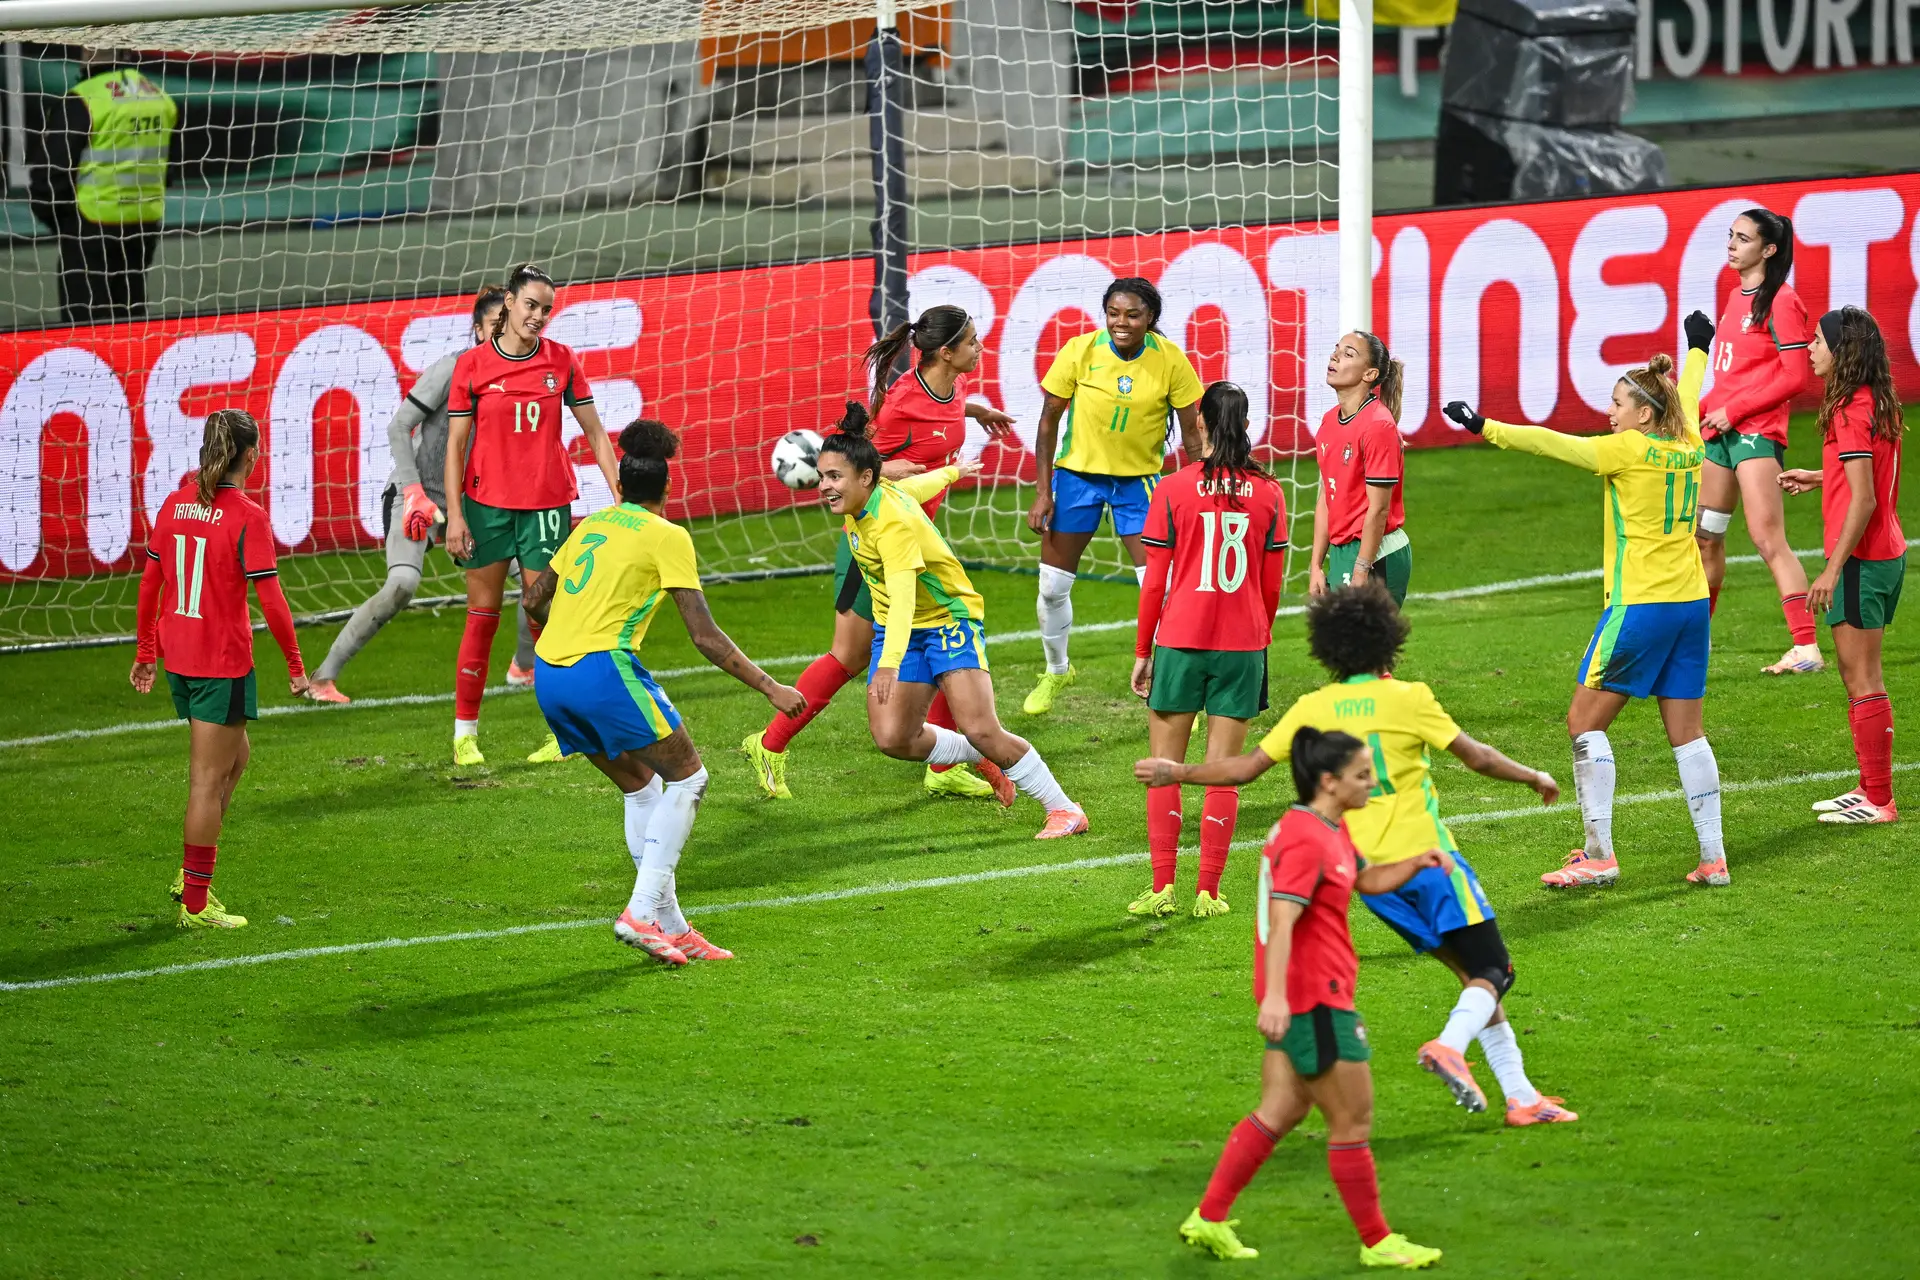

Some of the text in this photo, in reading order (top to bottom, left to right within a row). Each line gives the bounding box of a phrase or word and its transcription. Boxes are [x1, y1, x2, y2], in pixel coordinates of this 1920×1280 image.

[1715, 341, 1733, 372] 13
[514, 401, 541, 433] 19
[1110, 405, 1130, 433] 11
[1328, 477, 1337, 501] 3
[1664, 471, 1698, 535] 14
[173, 503, 224, 526] TATIANA P.
[538, 509, 561, 542] 19
[564, 533, 608, 595] 3
[1194, 511, 1250, 594] 18
[172, 533, 207, 619] 11
[939, 621, 966, 651] 13
[1333, 698, 1376, 719] YAYA
